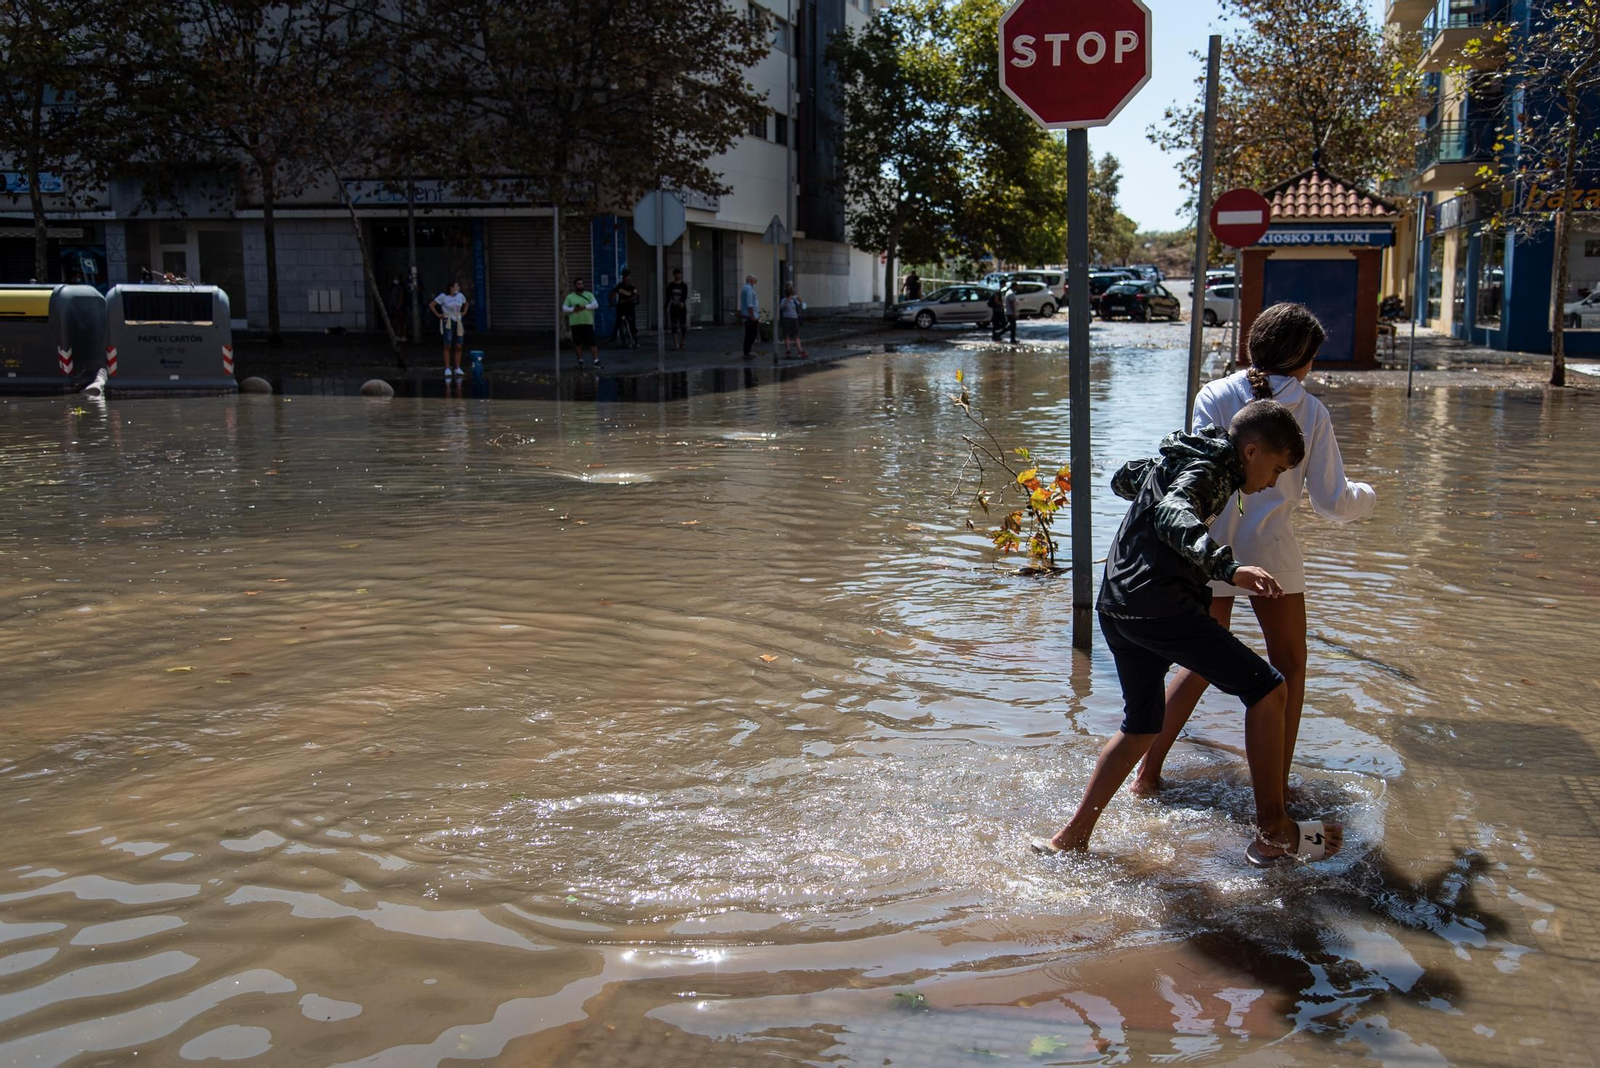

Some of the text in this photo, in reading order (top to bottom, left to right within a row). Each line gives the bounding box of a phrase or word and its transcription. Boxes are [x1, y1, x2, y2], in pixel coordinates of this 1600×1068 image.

[1010, 30, 1139, 68] STOP
[1258, 233, 1370, 243] KIOSKO EL KUKI
[169, 333, 203, 342] CARTÓN
